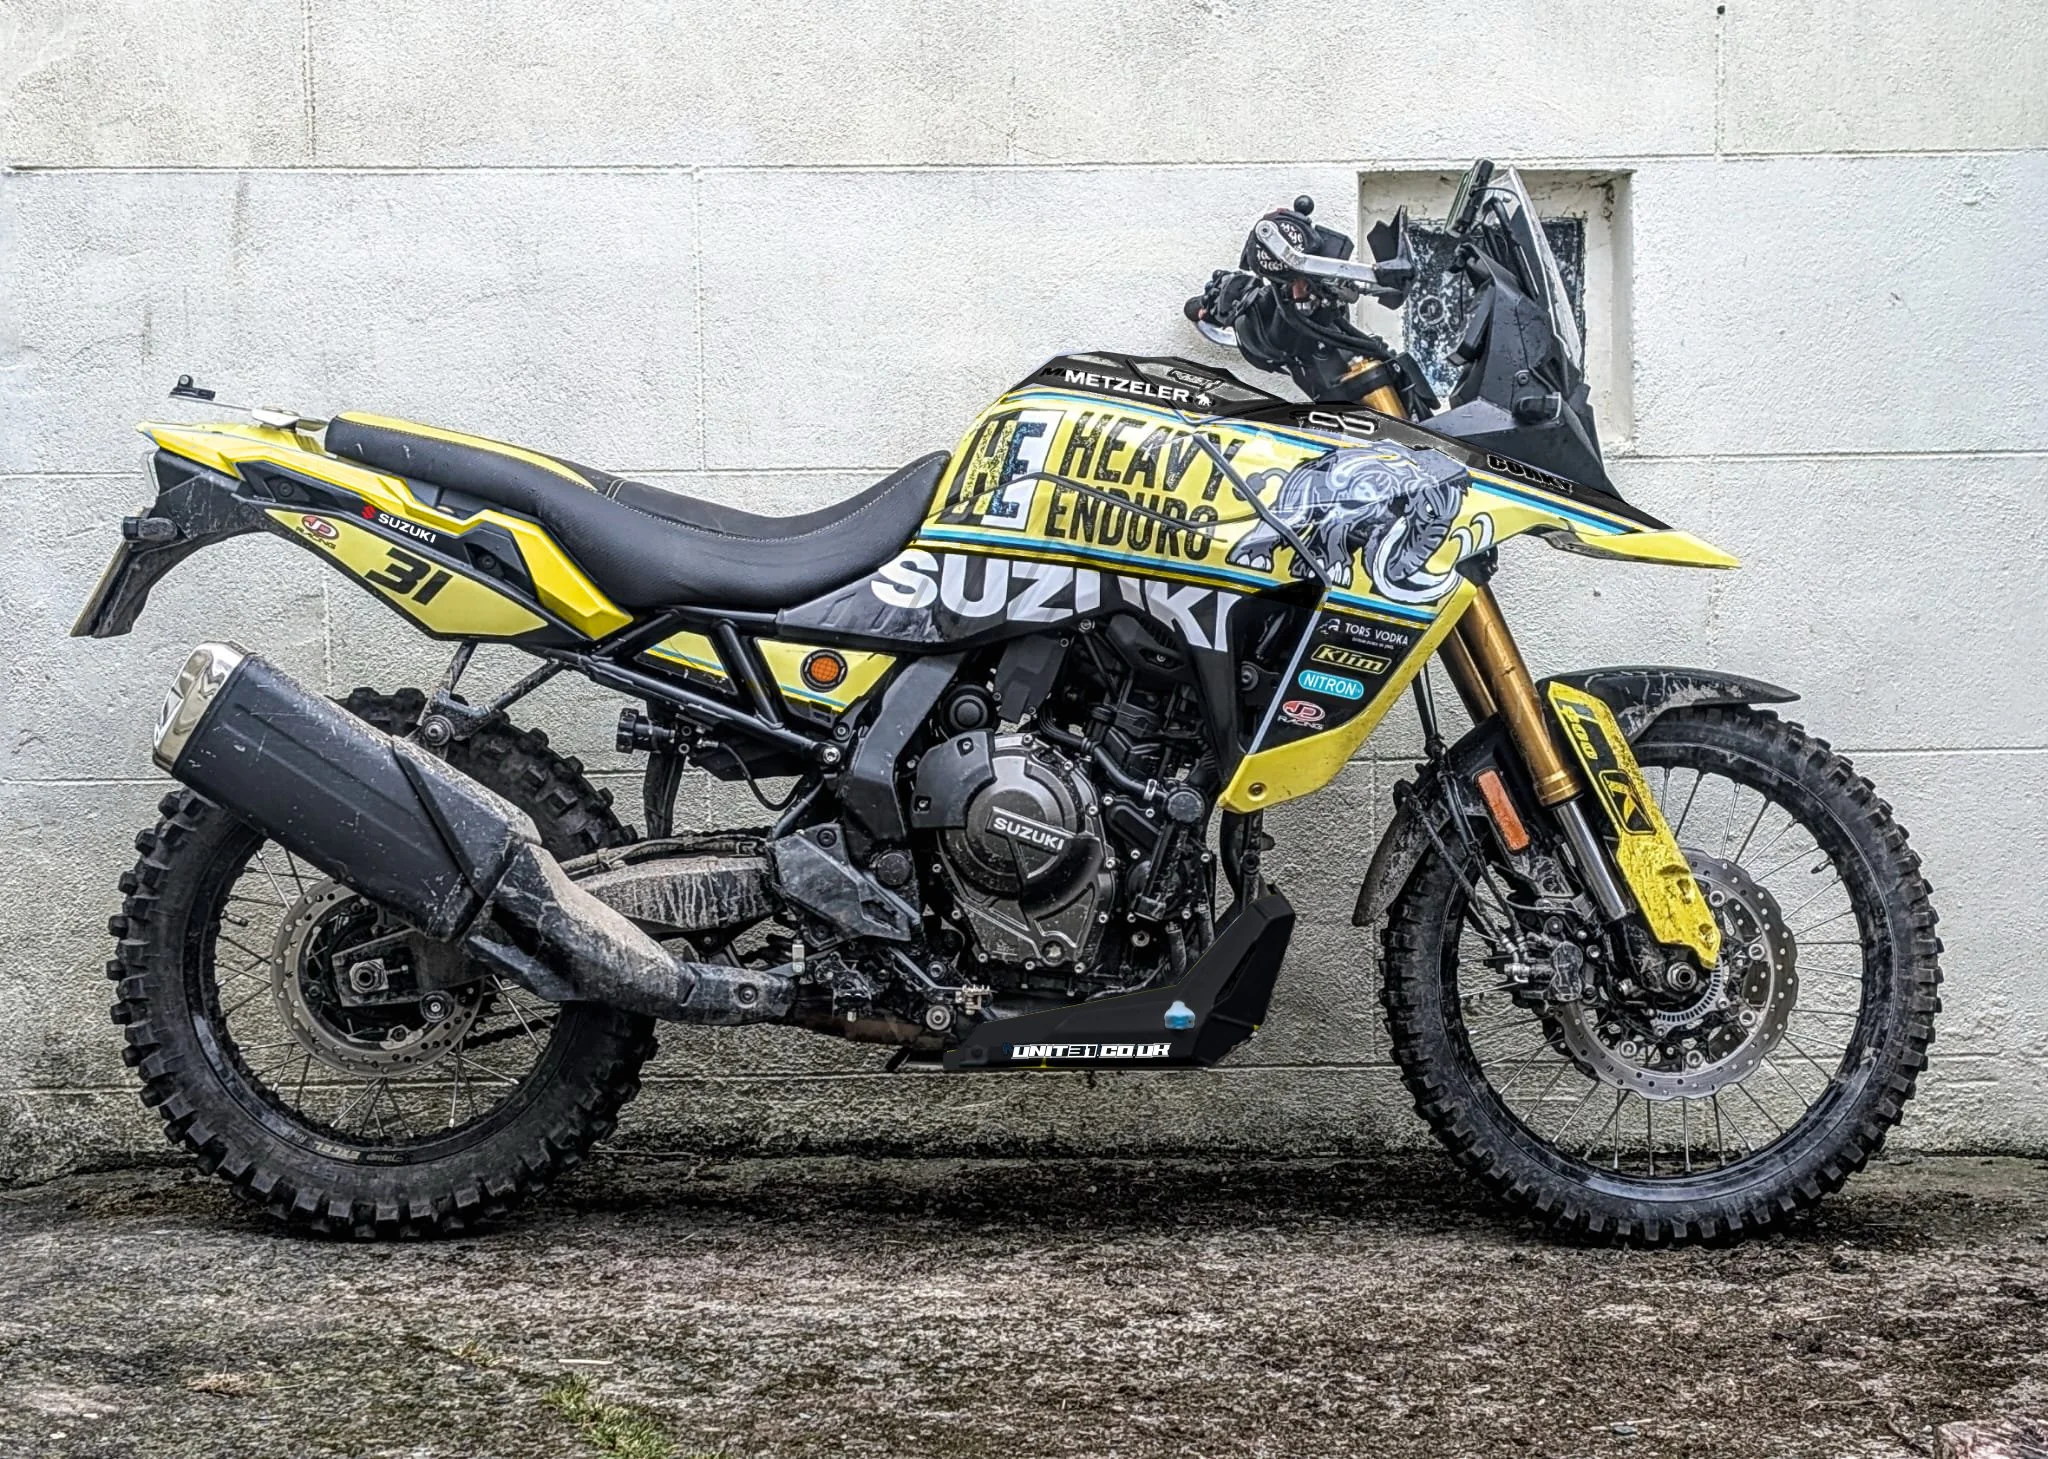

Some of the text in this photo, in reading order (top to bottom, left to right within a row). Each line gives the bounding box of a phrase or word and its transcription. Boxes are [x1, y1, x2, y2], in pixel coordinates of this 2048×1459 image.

[1064, 370, 1191, 403] METZELER
[1058, 410, 1246, 502] HEAVY
[377, 512, 437, 544] SUZUKI
[1044, 484, 1220, 561] ENDURO
[364, 547, 454, 607] 31
[1344, 622, 1372, 638] TORS
[1375, 629, 1409, 646] VODKA
[1303, 672, 1357, 697] NITRON
[992, 817, 1065, 851] SUZUKI
